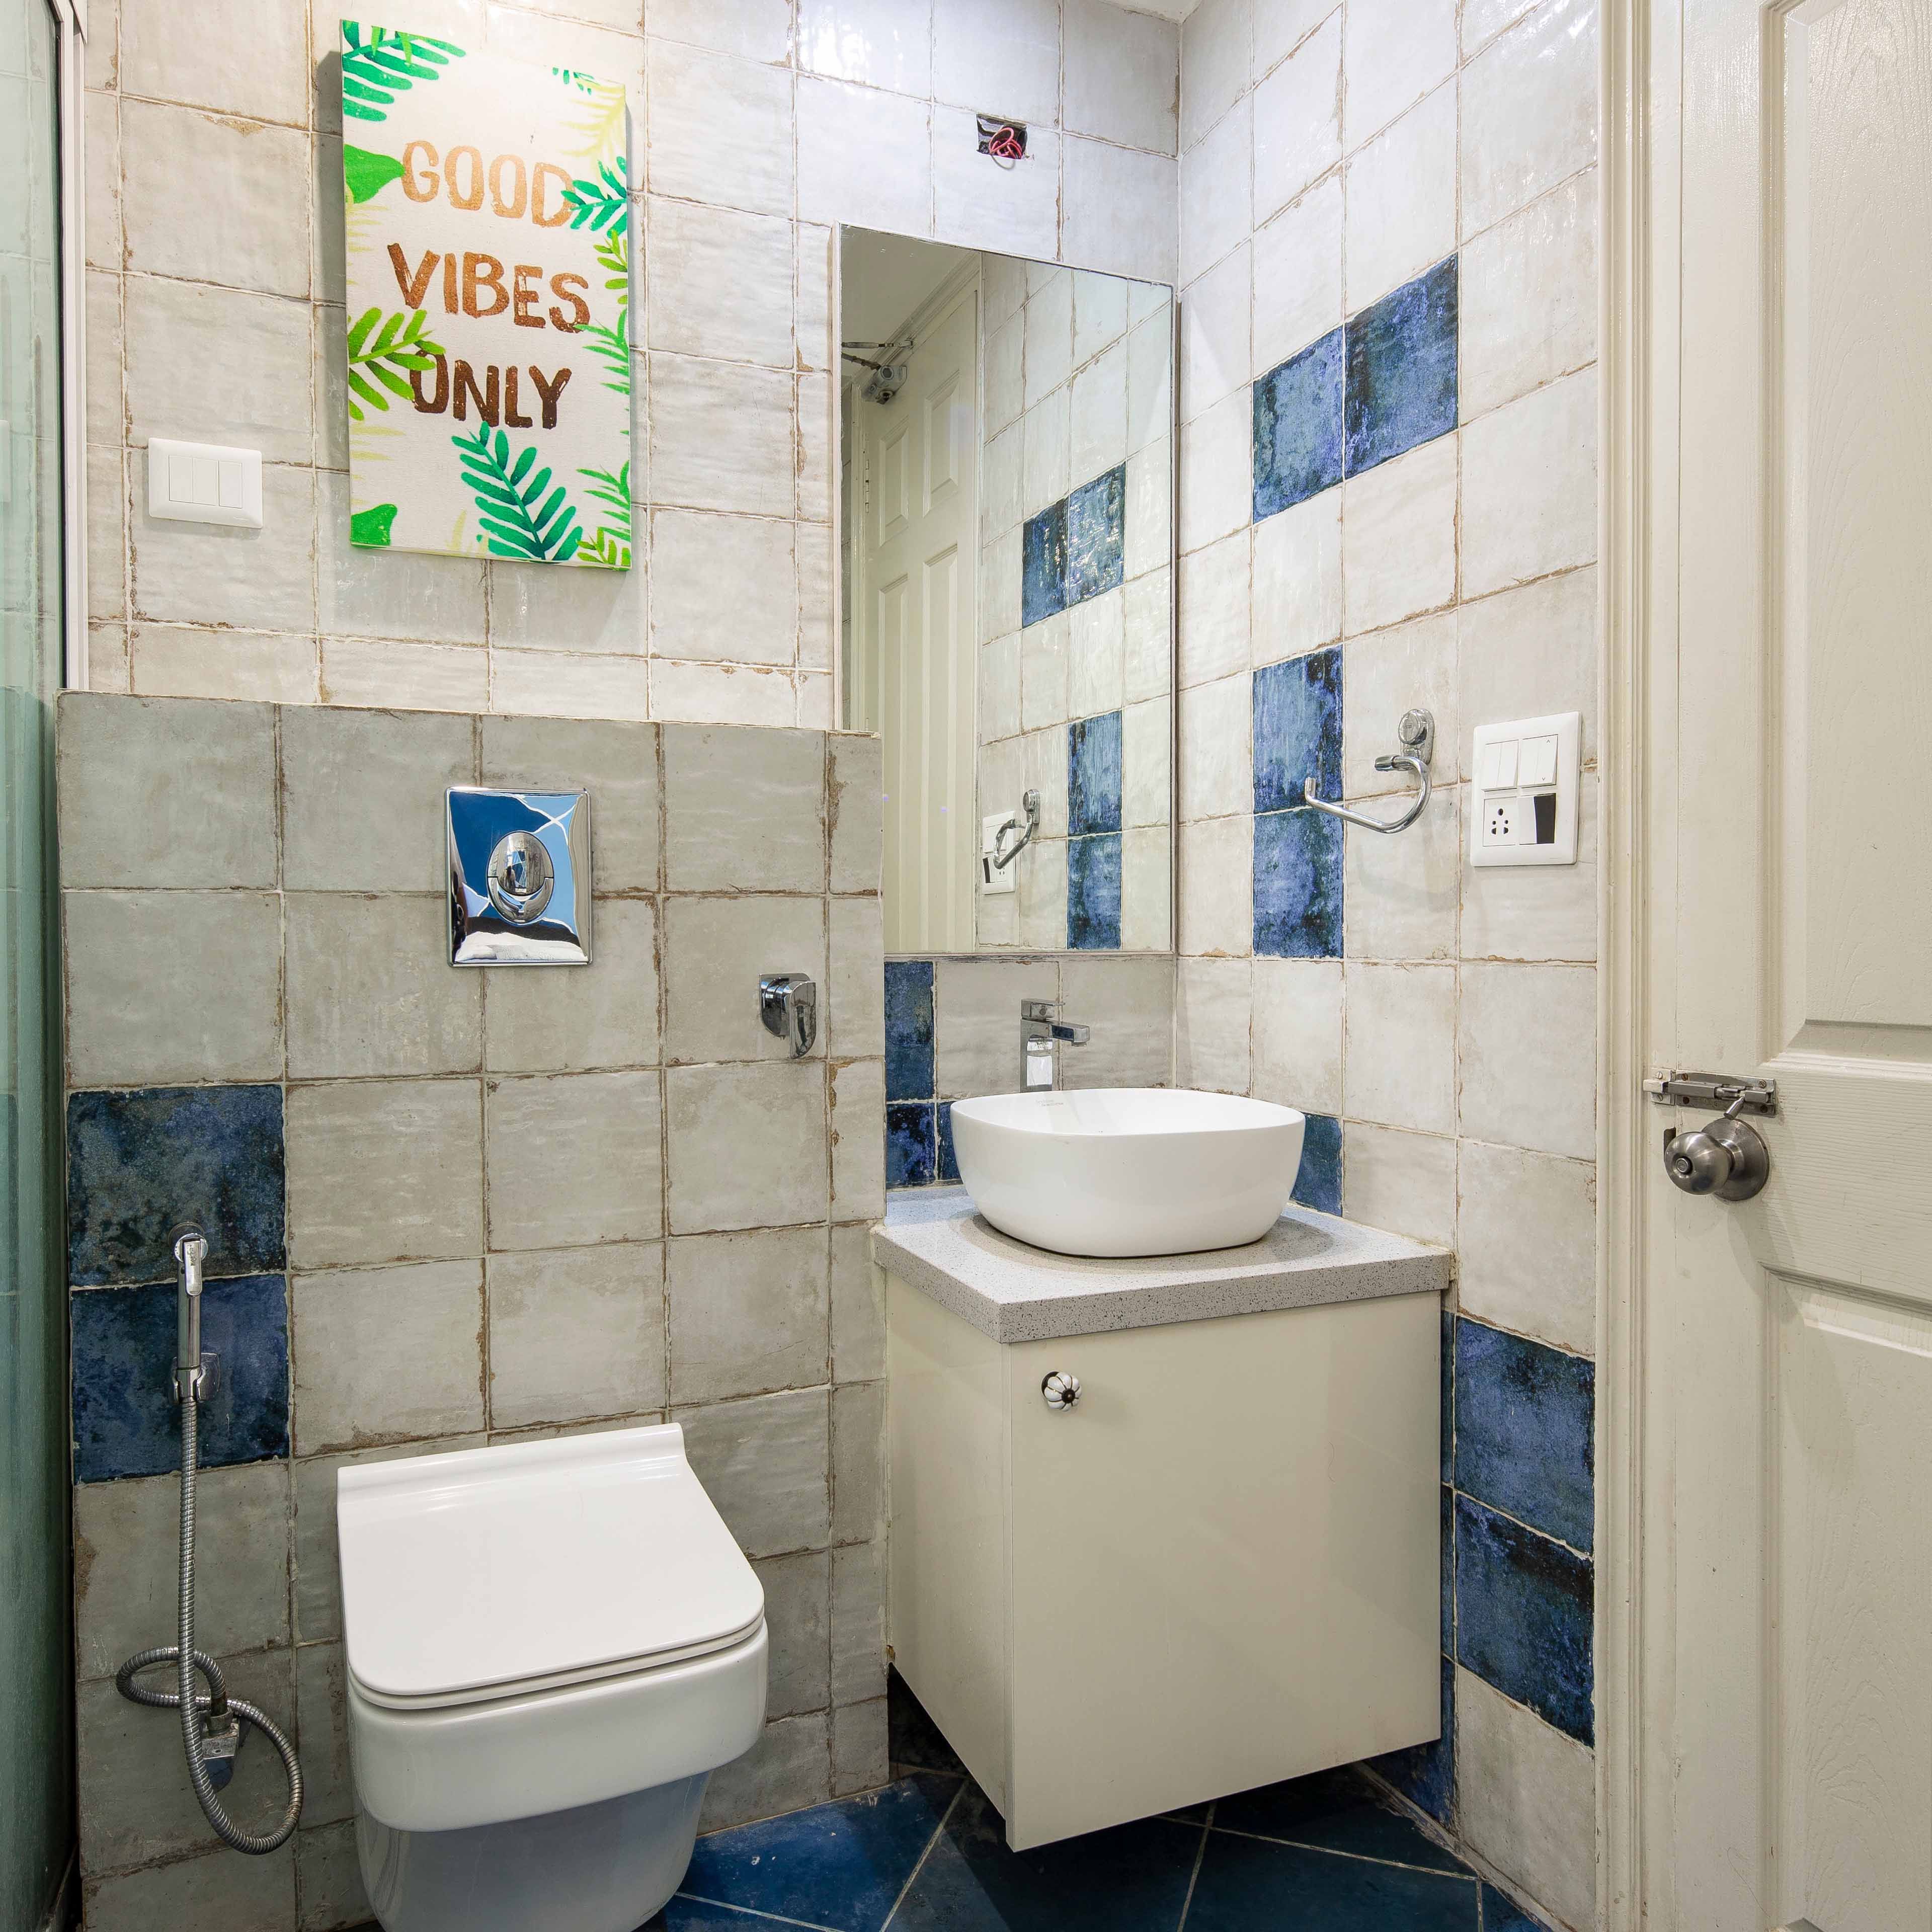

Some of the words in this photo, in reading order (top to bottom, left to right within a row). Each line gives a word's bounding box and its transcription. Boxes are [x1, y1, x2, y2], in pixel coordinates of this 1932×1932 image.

[402, 140, 576, 227] GOOD
[387, 243, 590, 333] VIBES
[410, 348, 572, 429] ONLY
